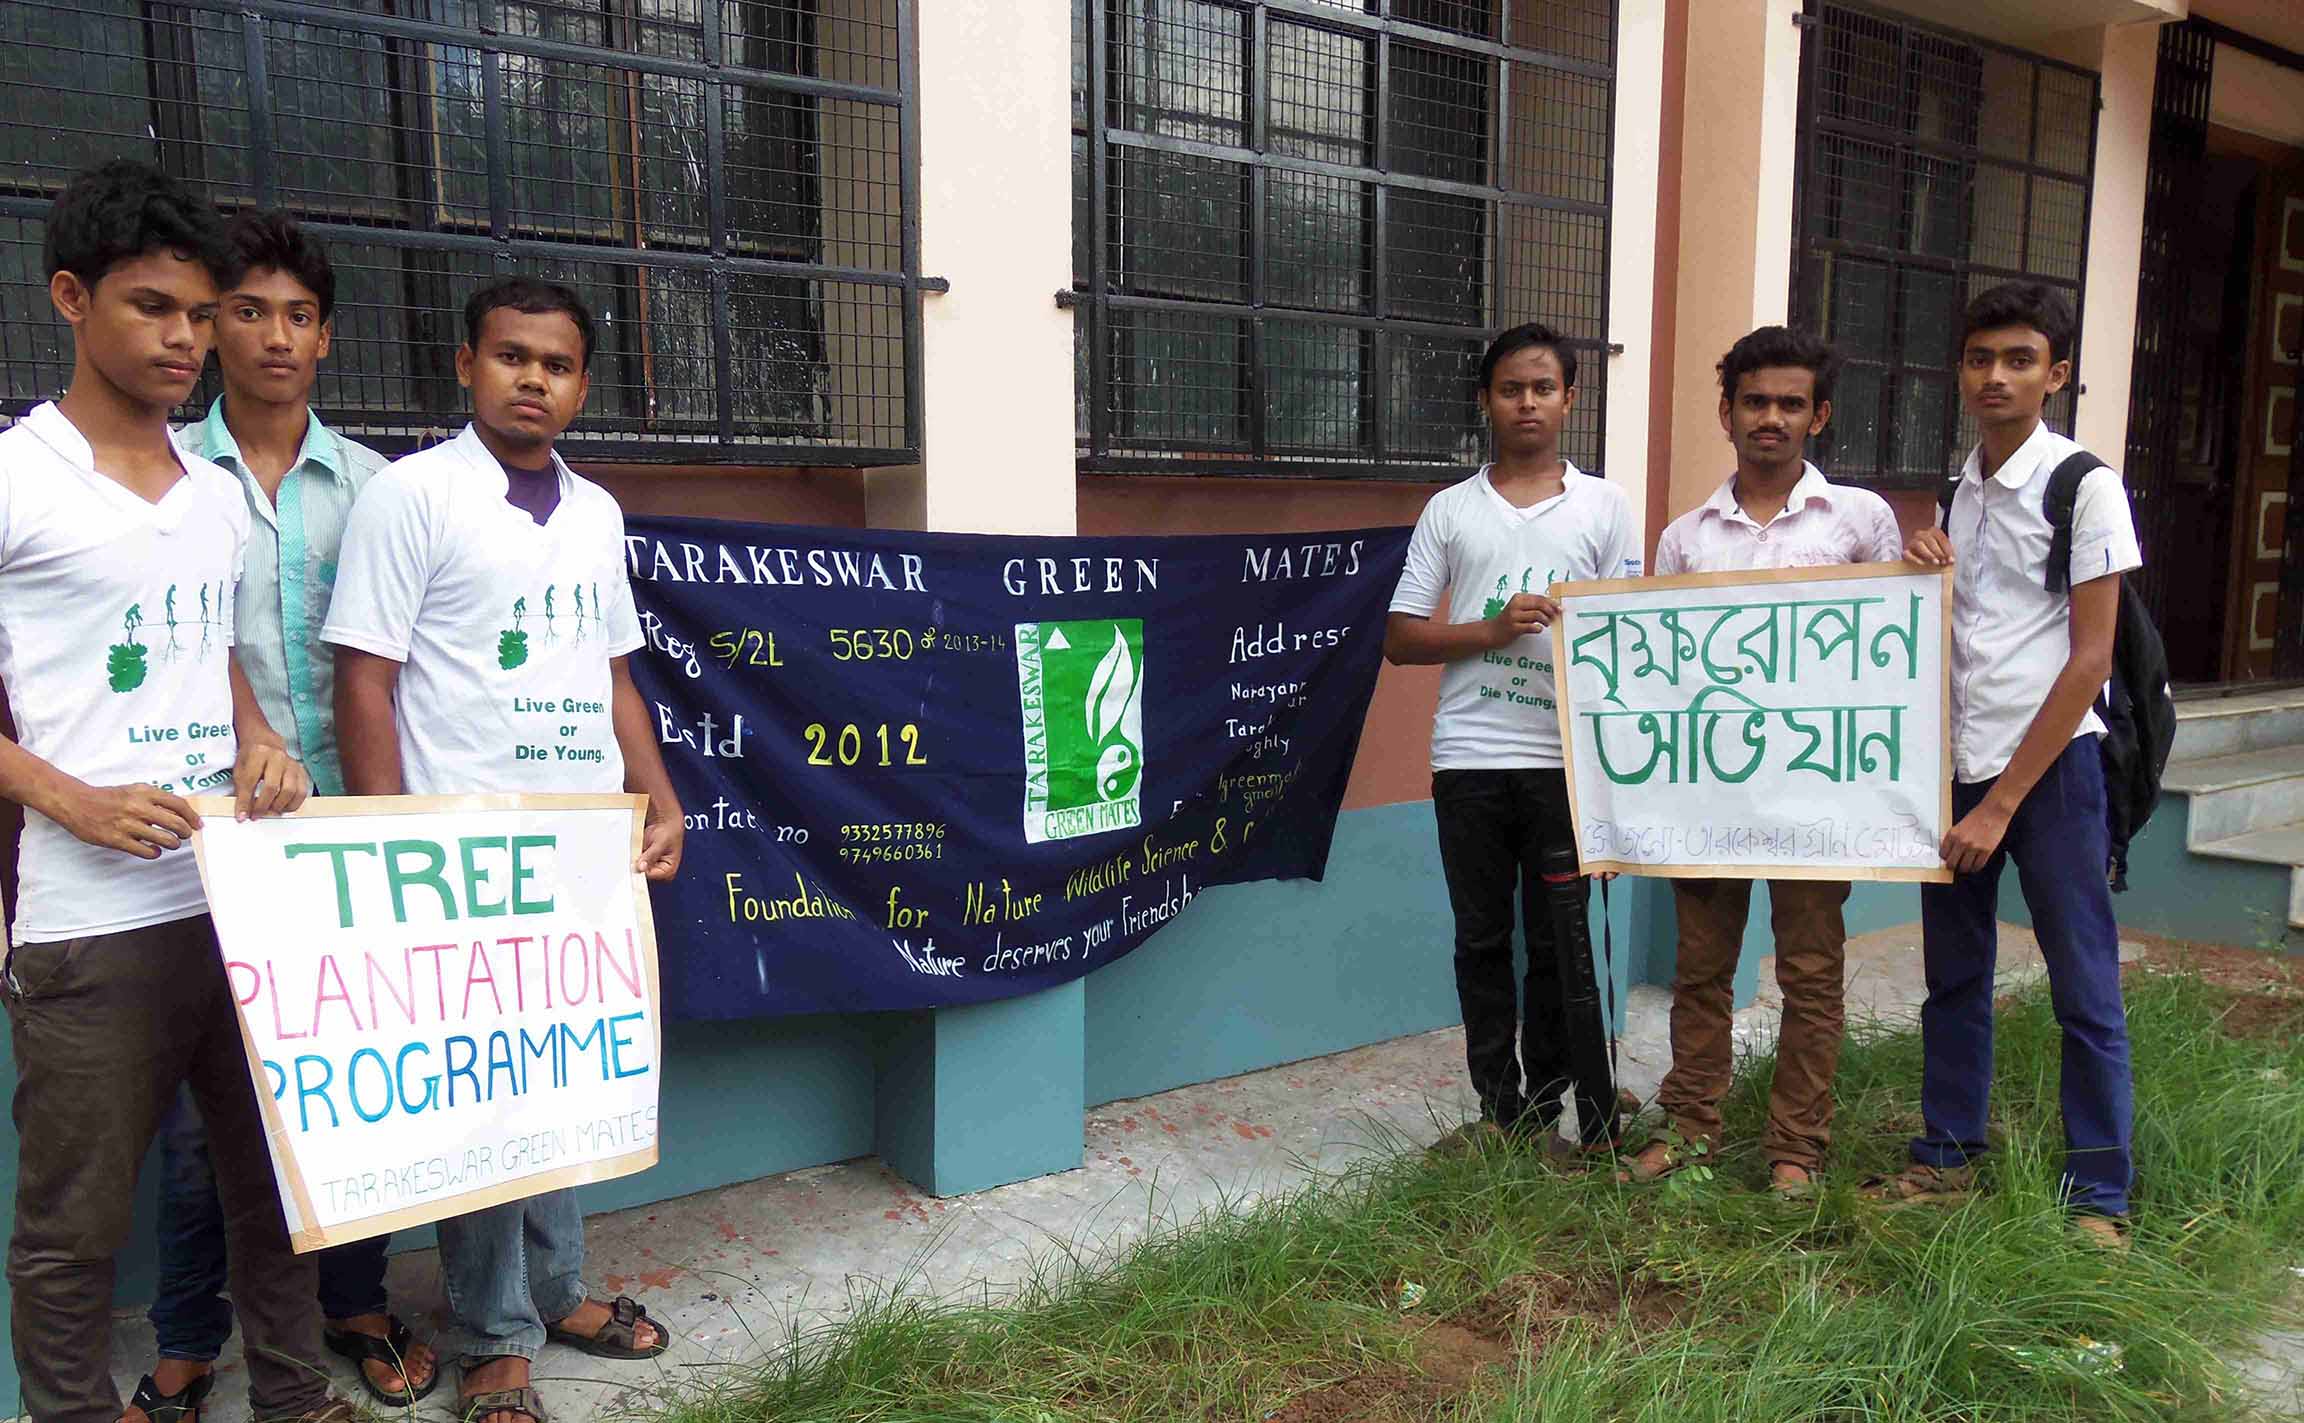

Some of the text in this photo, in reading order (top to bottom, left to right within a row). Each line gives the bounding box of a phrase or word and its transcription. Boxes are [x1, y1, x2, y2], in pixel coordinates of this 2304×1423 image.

[624, 535, 1365, 596] TARAKESWAR GREEN MATES
[638, 610, 701, 678] Reg
[829, 629, 914, 660] 5630
[944, 632, 1005, 652] 2013-14
[1571, 589, 1924, 711] বৃক্ষরোপন
[1483, 651, 1554, 674] Live Gree
[1480, 686, 1501, 699] Die
[1511, 674, 1527, 688] or
[514, 697, 556, 713] Live
[1019, 629, 1049, 812] TARAKESWAR
[128, 725, 179, 744] Live
[559, 725, 578, 737] or
[804, 723, 928, 766] 2012
[185, 751, 206, 766] or
[515, 745, 605, 764] Die Young.
[181, 768, 233, 791] Youn
[777, 825, 808, 844] no
[841, 823, 946, 841] 9332577896
[1045, 806, 1095, 839] GREEN
[1100, 798, 1140, 828] MATES
[839, 844, 943, 865] 9749660361
[284, 834, 557, 928] TREE
[887, 886, 929, 929] for
[963, 879, 1043, 926] Nature
[1142, 834, 1200, 875] Science
[1209, 816, 1229, 853] &
[892, 873, 1203, 978] Nature deserves your Friendsh
[225, 928, 643, 1041] PLANTATION
[262, 1011, 650, 1132] PROGRAMME
[321, 1105, 657, 1215] TARAKESWAR GREEN MATES
